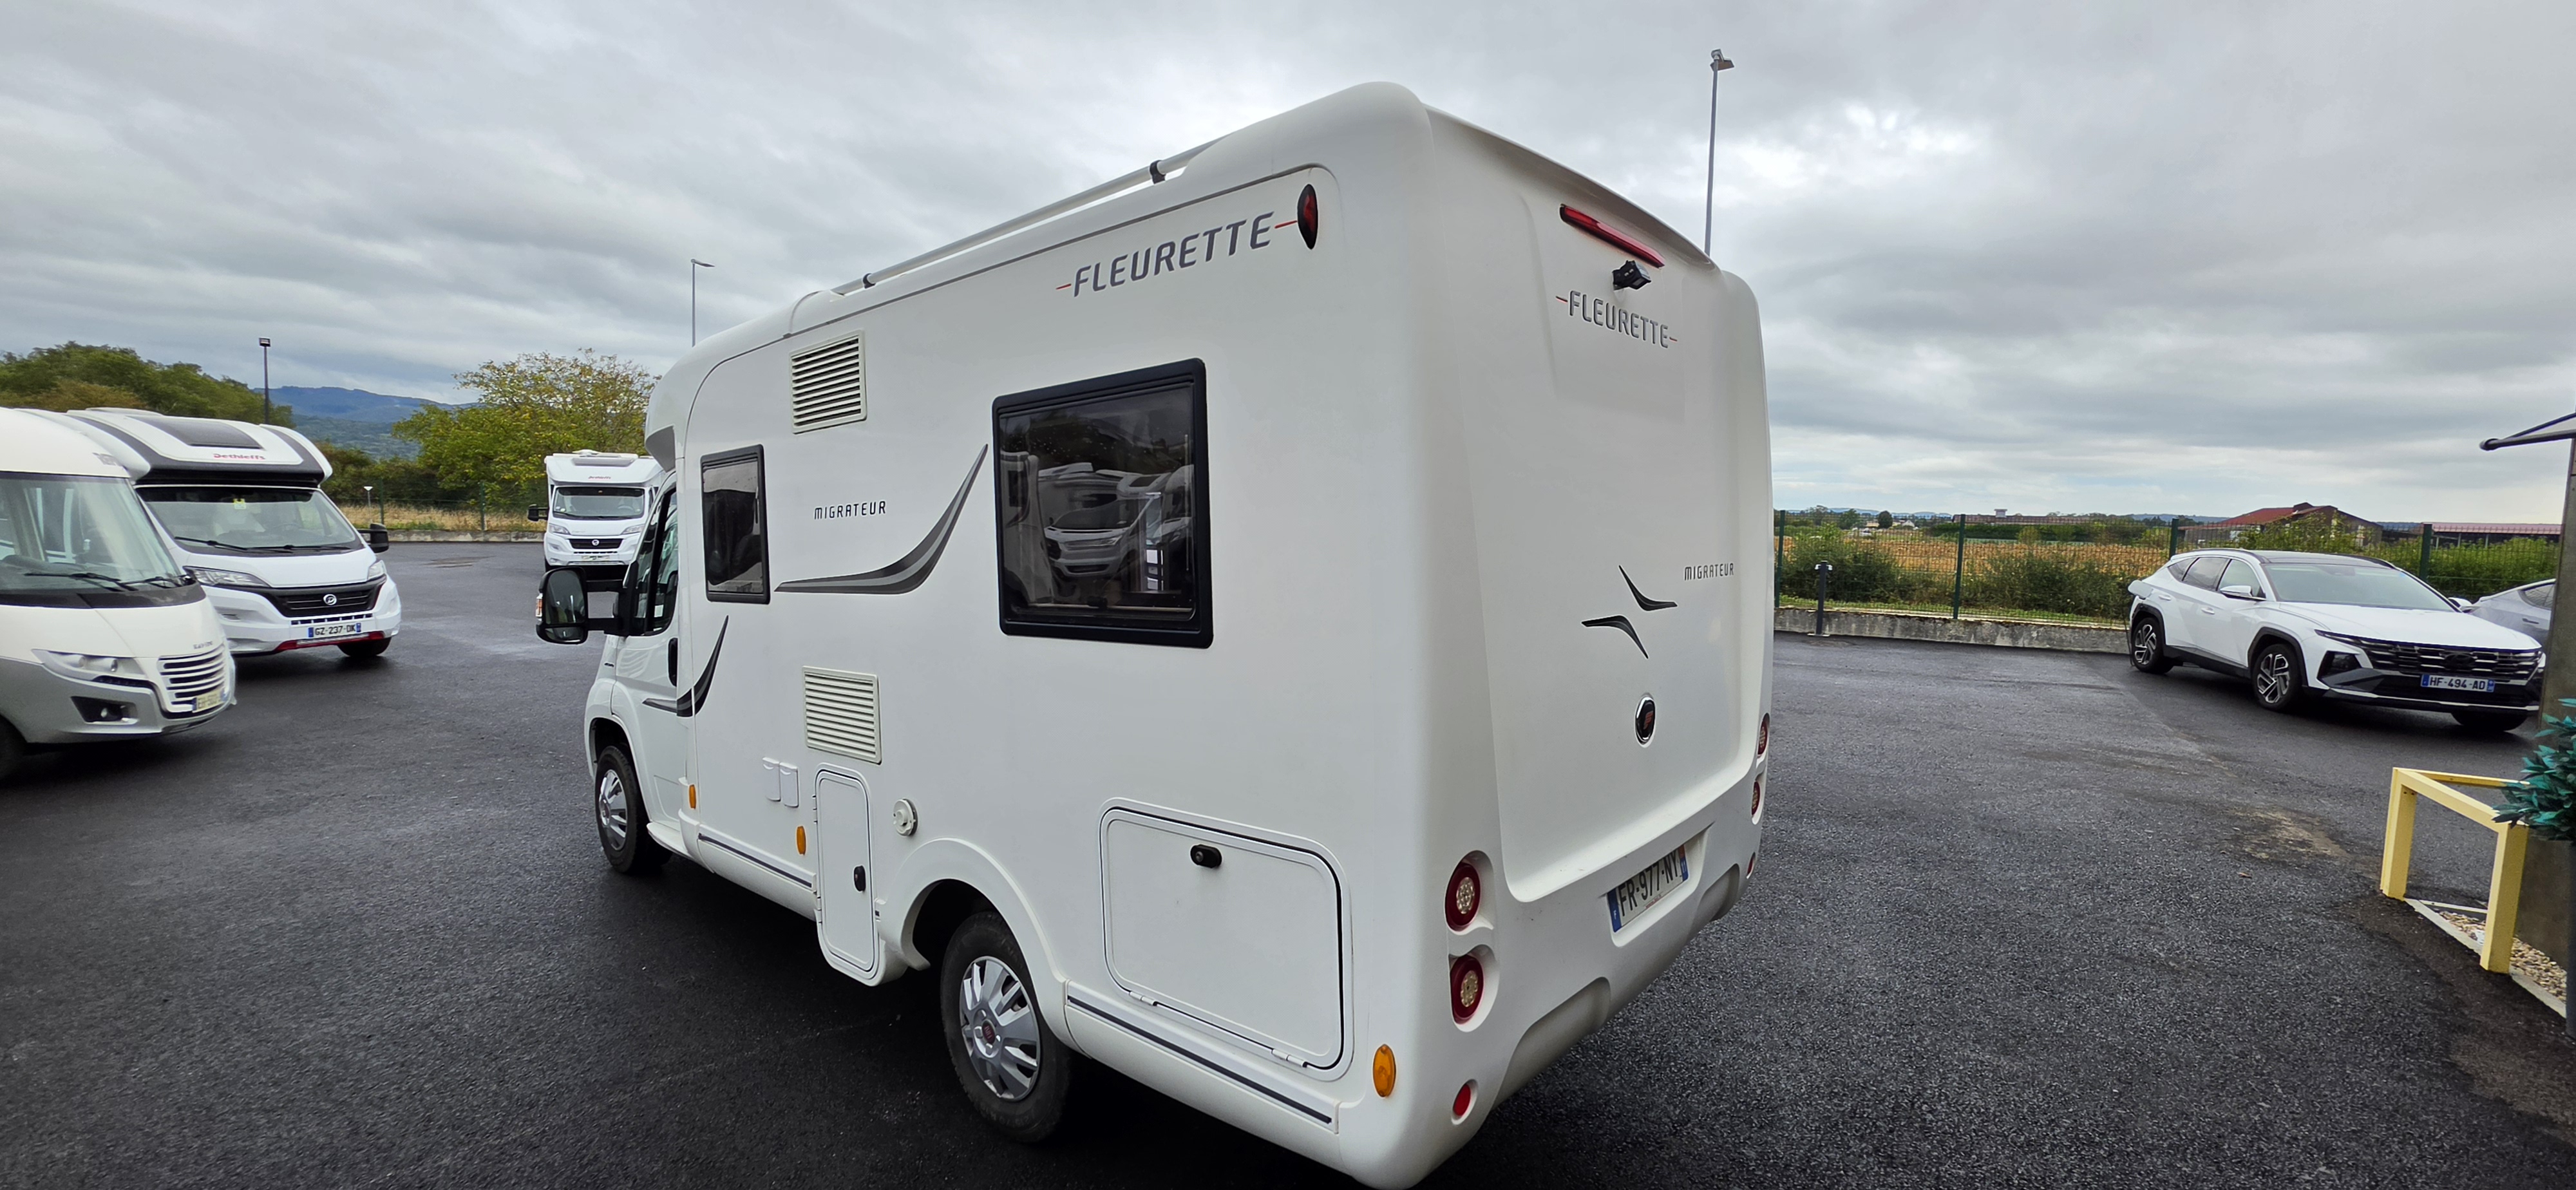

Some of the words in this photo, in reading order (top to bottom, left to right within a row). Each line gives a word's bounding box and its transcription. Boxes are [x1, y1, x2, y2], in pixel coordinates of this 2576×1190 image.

[1074, 211, 1274, 298] FLEURETTE
[1569, 290, 1669, 348] FLEURETTE
[814, 500, 886, 520] MIGRATEUR
[1684, 563, 1734, 581] MIGRATEUR
[315, 624, 356, 636] GZ-237-DK
[2430, 677, 2486, 690] HF-494-AD
[1617, 848, 1678, 917] FR-977-NY
